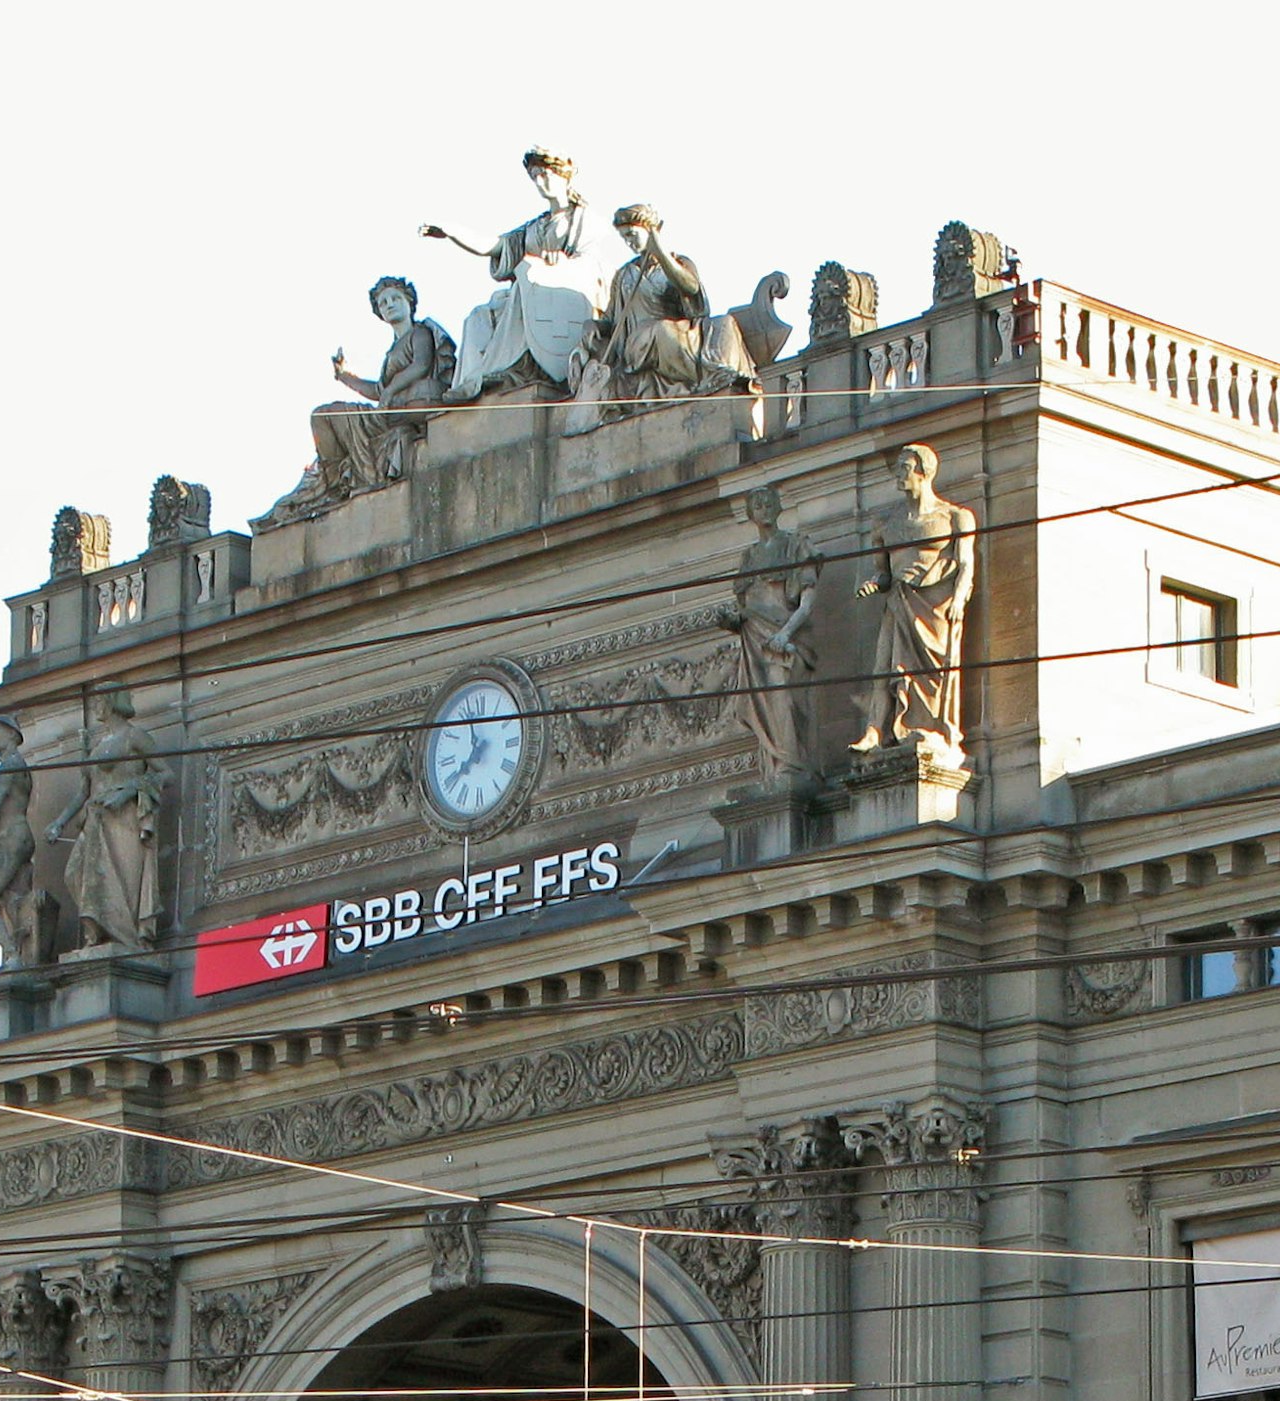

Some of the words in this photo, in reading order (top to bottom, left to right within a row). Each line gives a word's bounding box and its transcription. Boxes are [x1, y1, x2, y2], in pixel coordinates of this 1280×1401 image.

[335, 888, 421, 954] SBB
[433, 863, 520, 930] CFF
[533, 841, 619, 907] FFS
